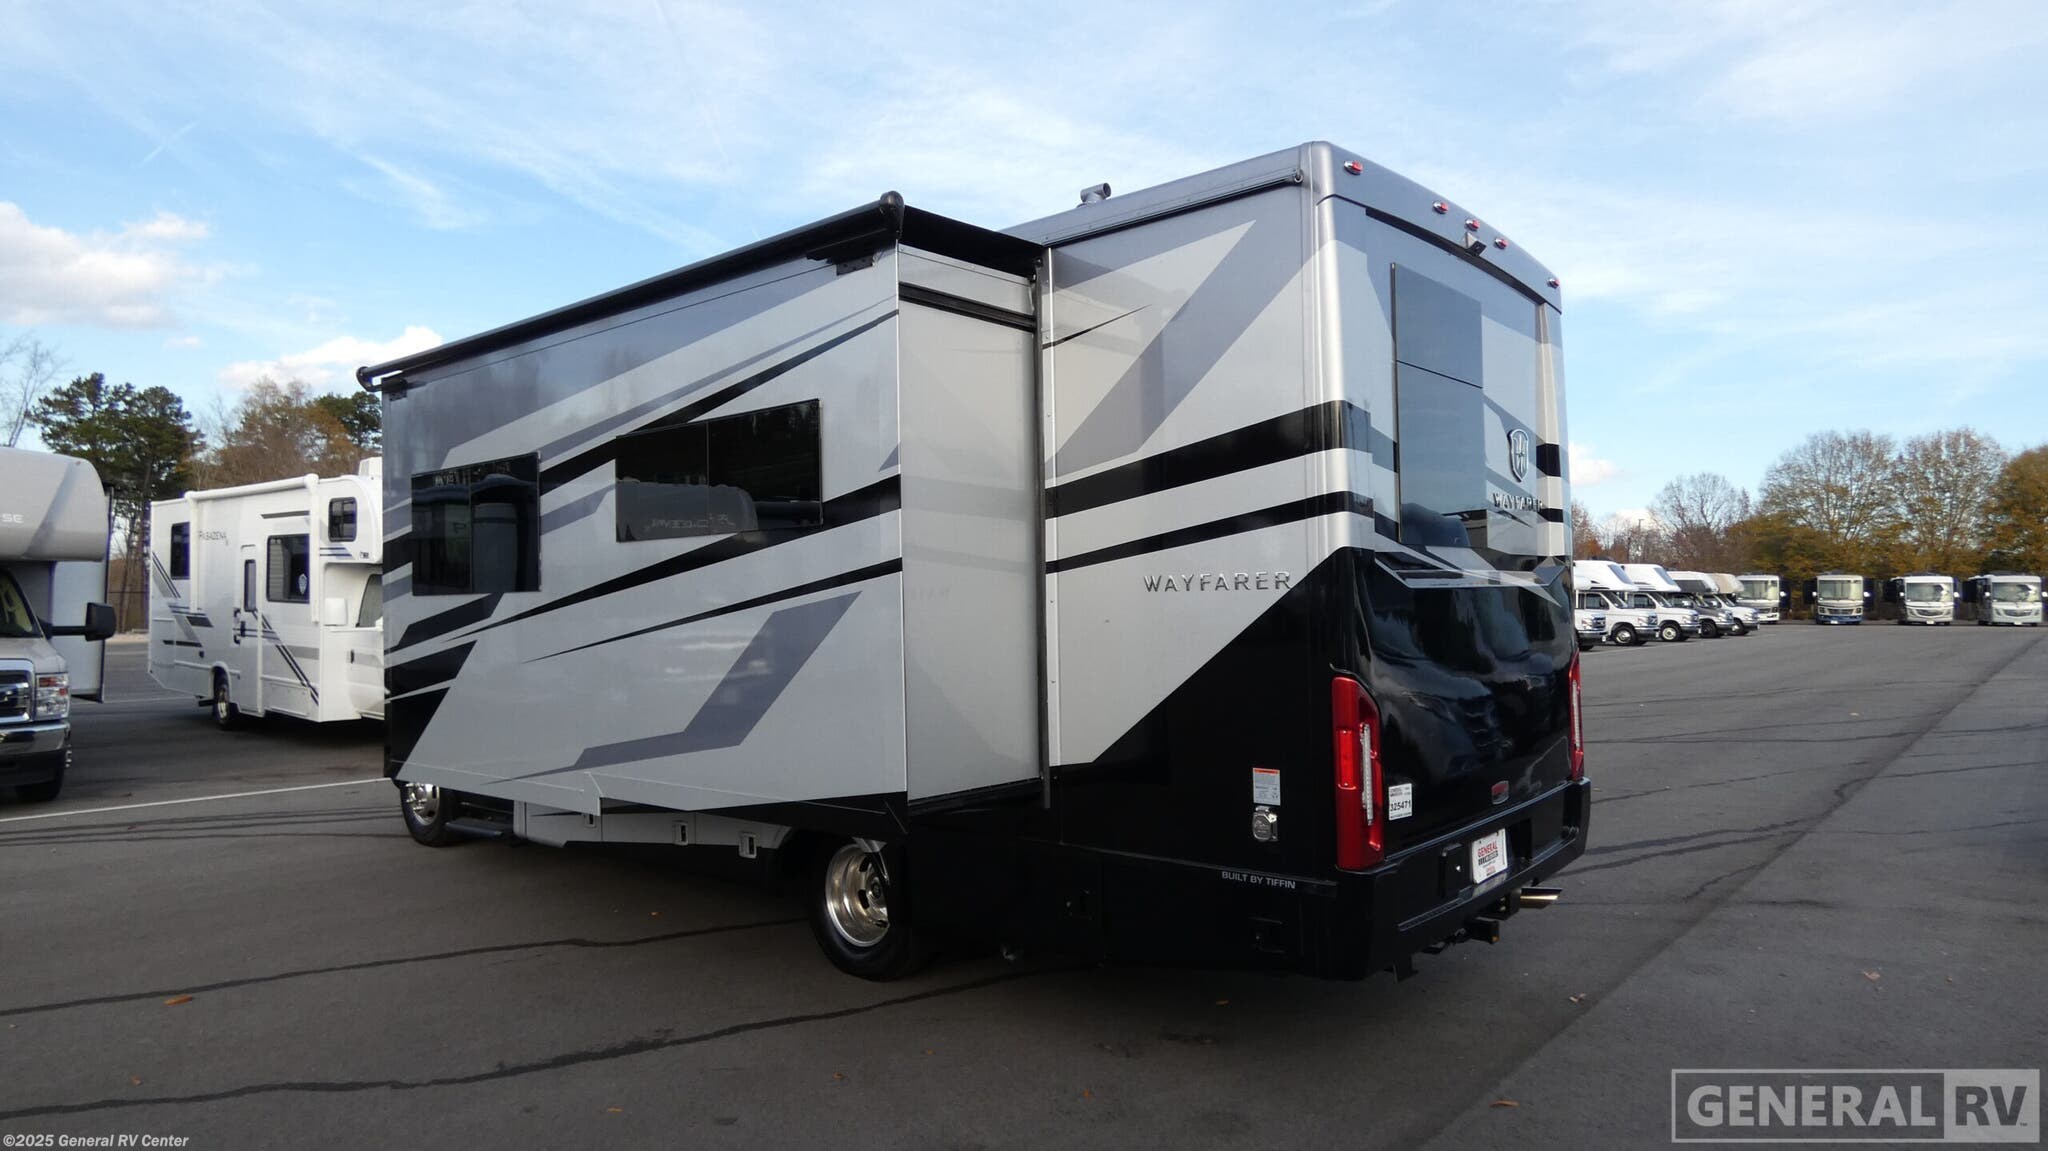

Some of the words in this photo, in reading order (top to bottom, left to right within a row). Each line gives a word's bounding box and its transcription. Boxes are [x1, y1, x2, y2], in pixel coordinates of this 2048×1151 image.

[1493, 492, 1543, 513] WAYFARER
[1144, 571, 1292, 592] WAYFARER
[1222, 871, 1248, 882] BUILT
[1250, 875, 1264, 884] BY
[1265, 877, 1296, 889] TIFFIN
